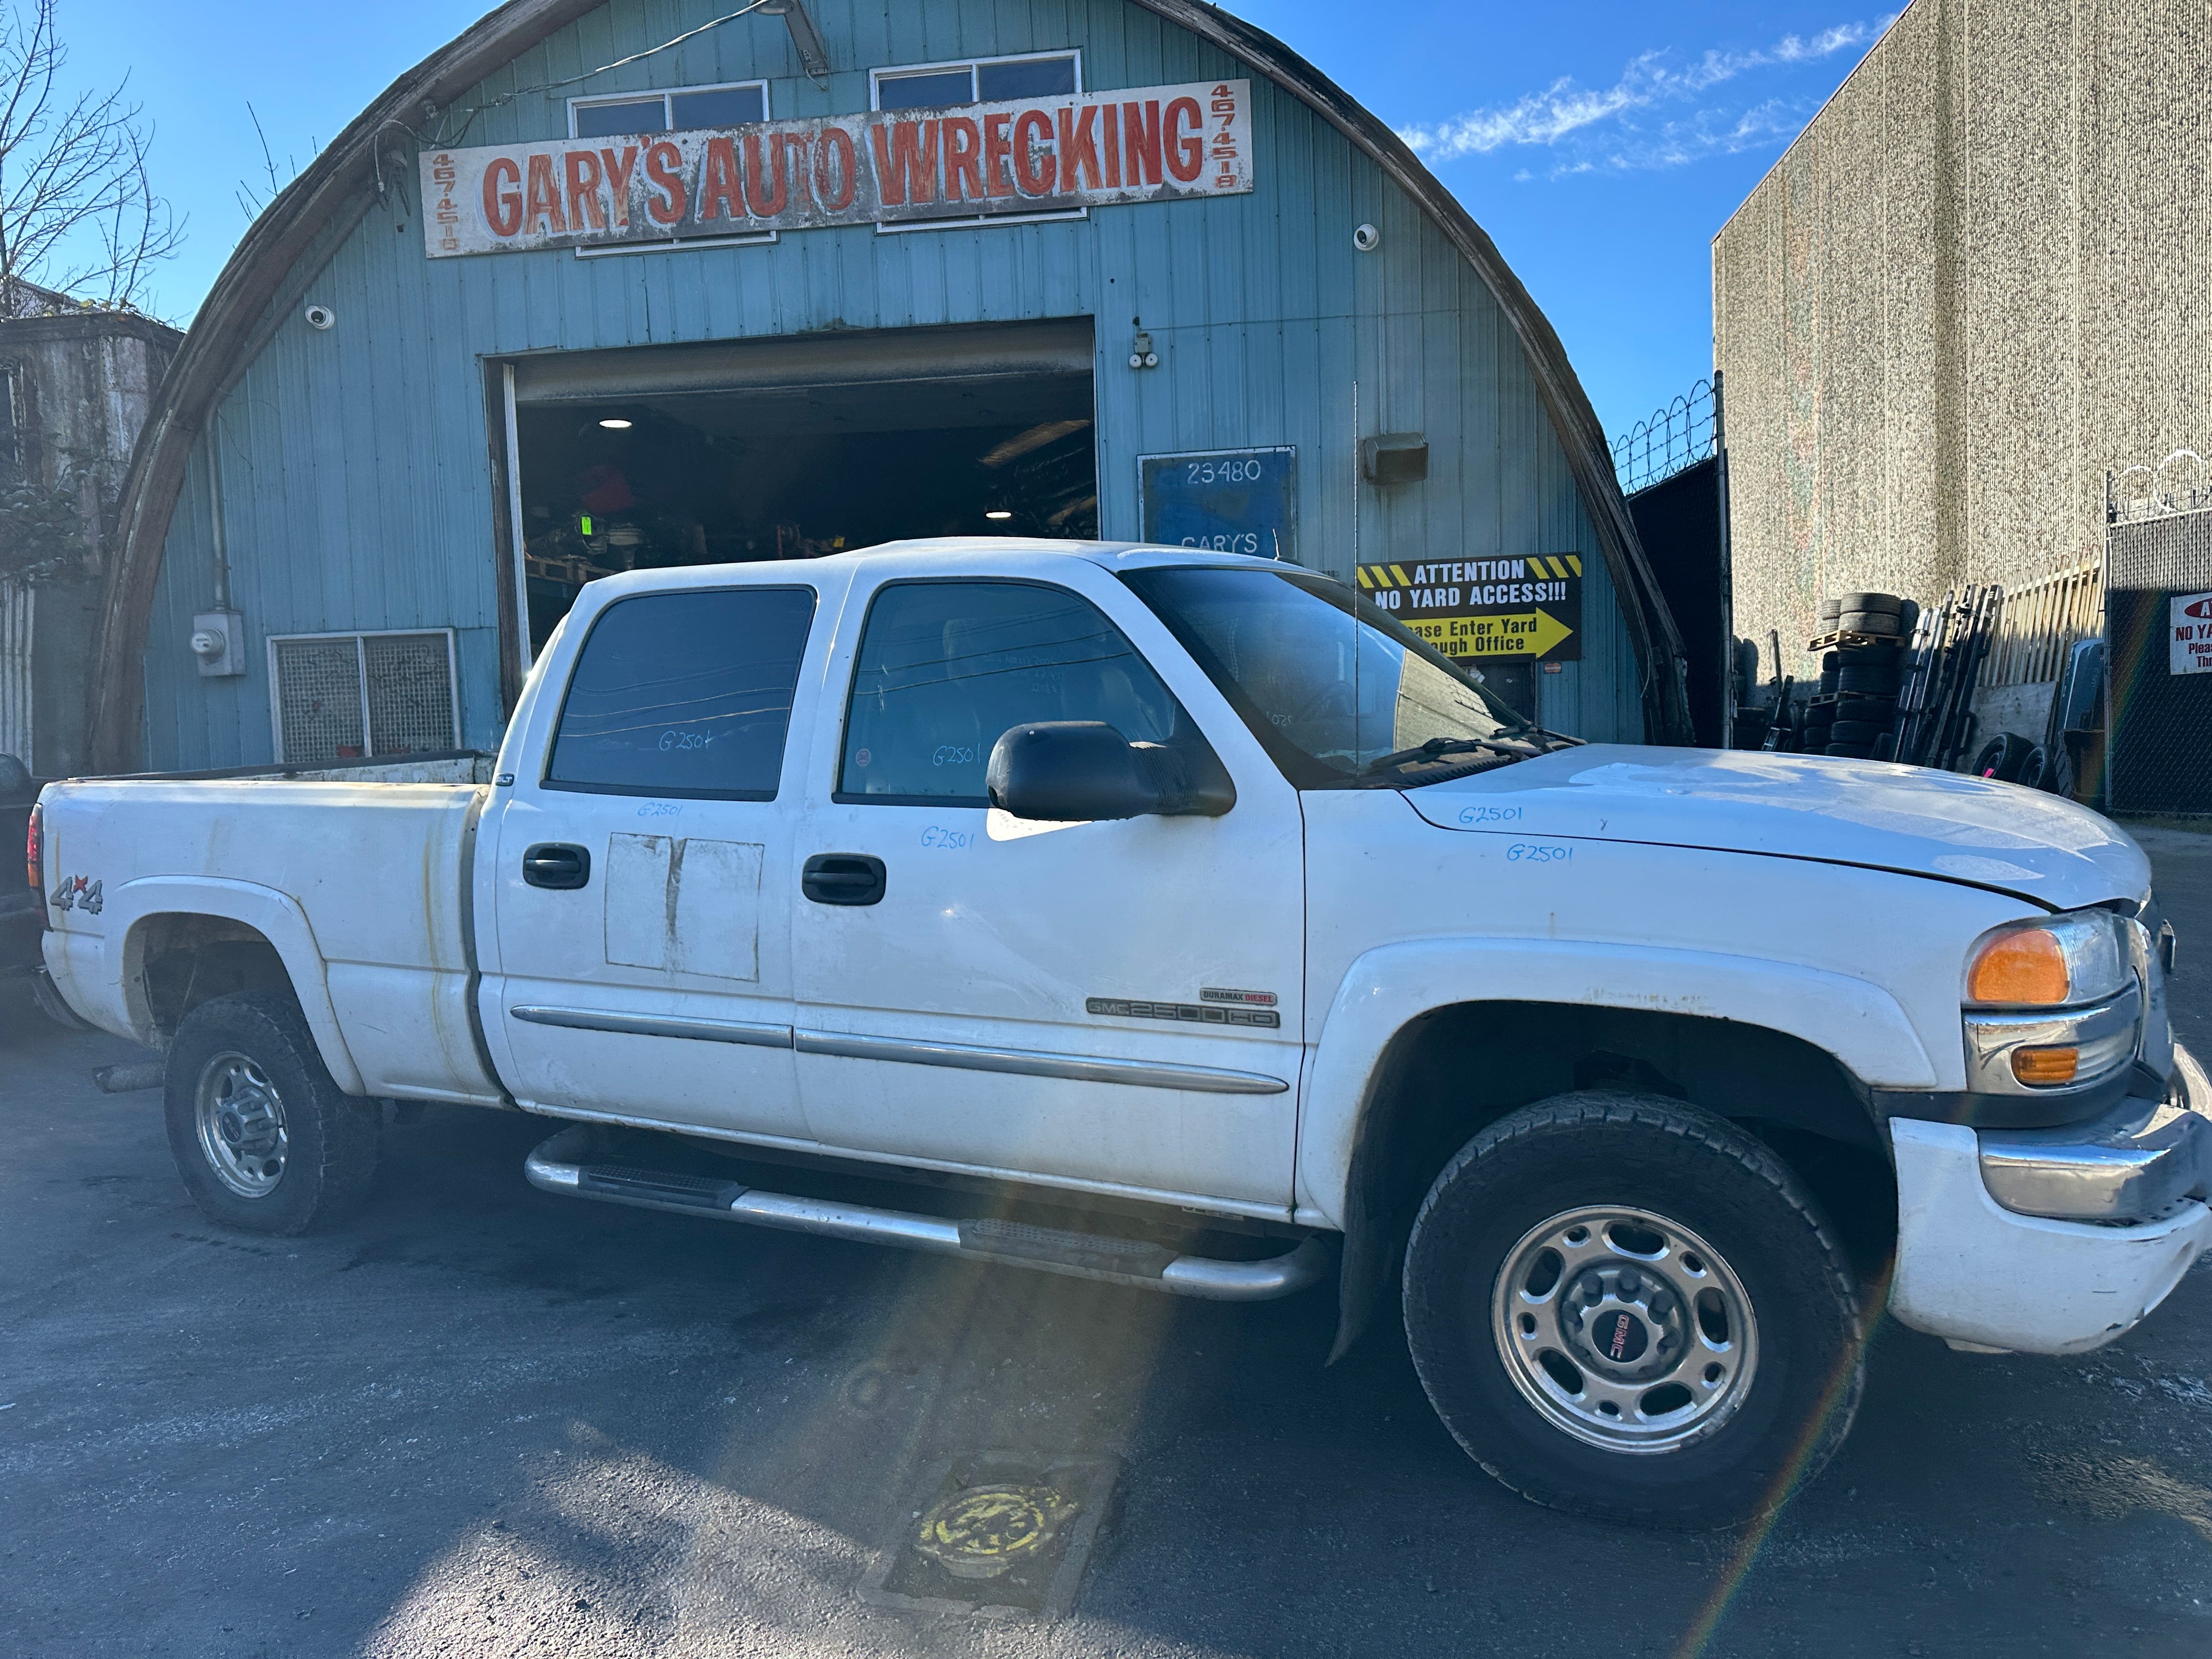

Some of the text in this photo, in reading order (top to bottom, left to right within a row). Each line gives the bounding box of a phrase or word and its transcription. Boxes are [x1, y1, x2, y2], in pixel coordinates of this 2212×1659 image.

[482, 96, 1203, 237] GARY'S AUTO WRECKING
[1187, 459, 1262, 484] 23480
[1414, 559, 1525, 584] ATTENTION
[1375, 581, 1566, 609] NO YARD ACCESS!!!
[1450, 620, 1494, 636] Enter
[1501, 617, 1537, 634] Yard
[2176, 626, 2193, 641] NO
[1475, 636, 1524, 652] Office
[933, 743, 980, 766] G2501
[637, 802, 683, 817] G2501
[1459, 806, 1521, 824] G2501
[922, 825, 974, 851] G2501
[1507, 843, 1573, 862] G2501
[1203, 990, 1273, 1003] DURAMAX DIESEL
[1088, 1001, 1130, 1015] GMC
[1610, 1314, 1630, 1359] GMC
